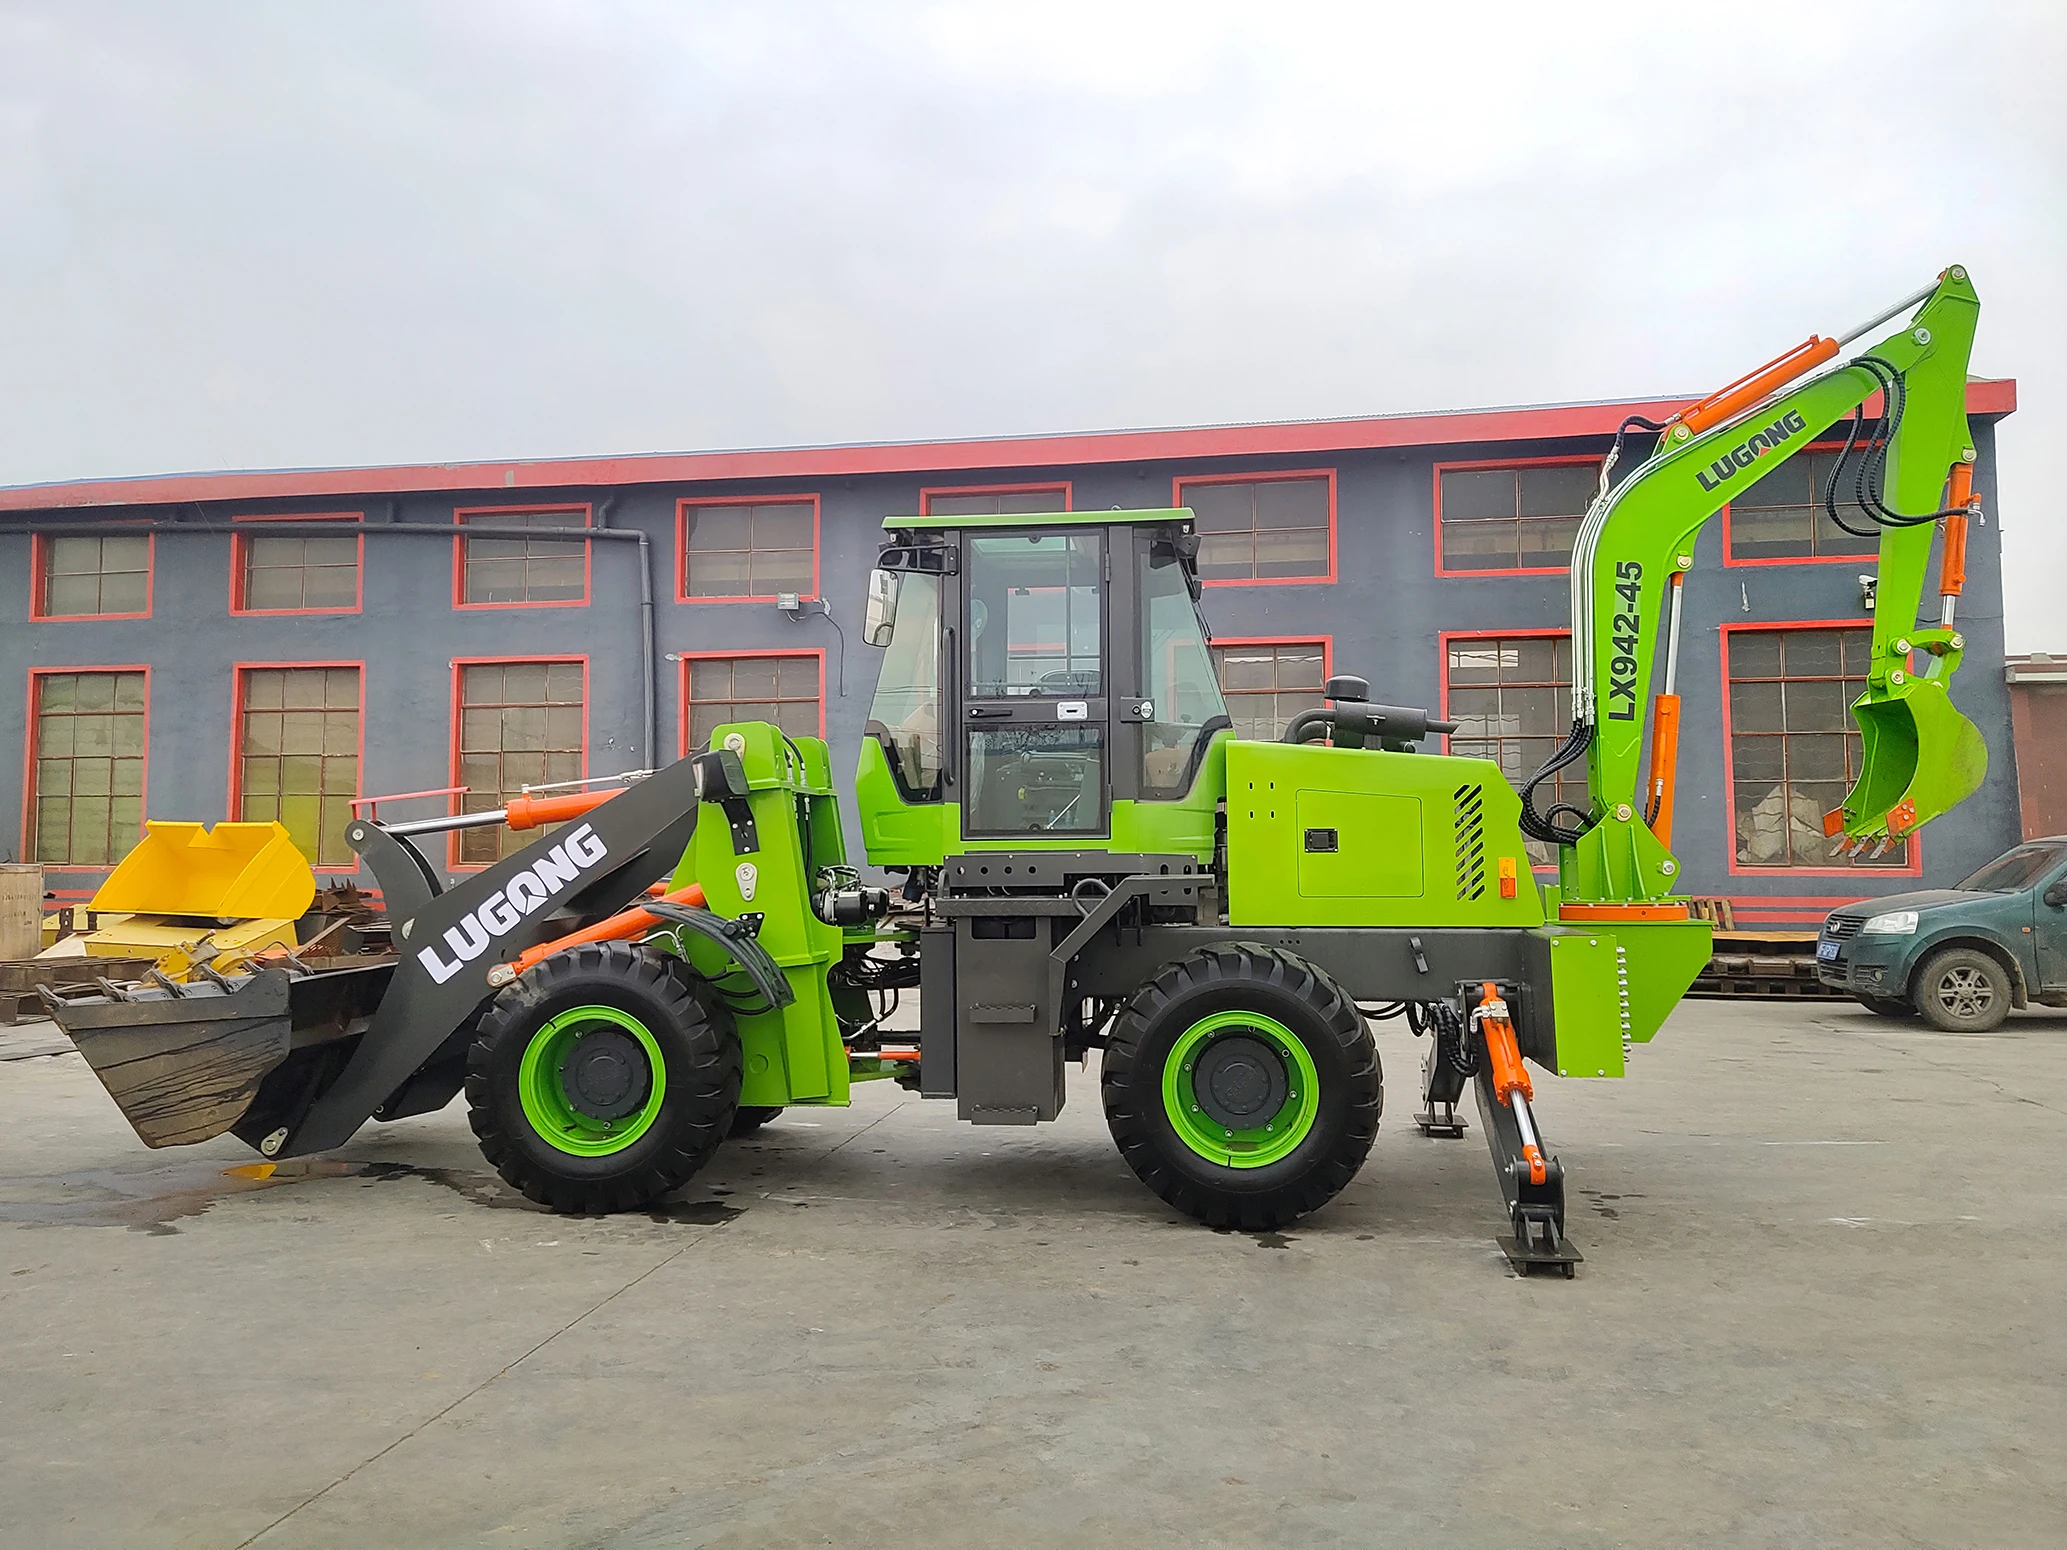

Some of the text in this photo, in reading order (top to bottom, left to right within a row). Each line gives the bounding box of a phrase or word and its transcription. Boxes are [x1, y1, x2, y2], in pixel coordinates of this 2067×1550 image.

[1696, 409, 1807, 492] LUGONG
[1608, 561, 1643, 721] LX942-45
[417, 823, 608, 984] LUGONG
